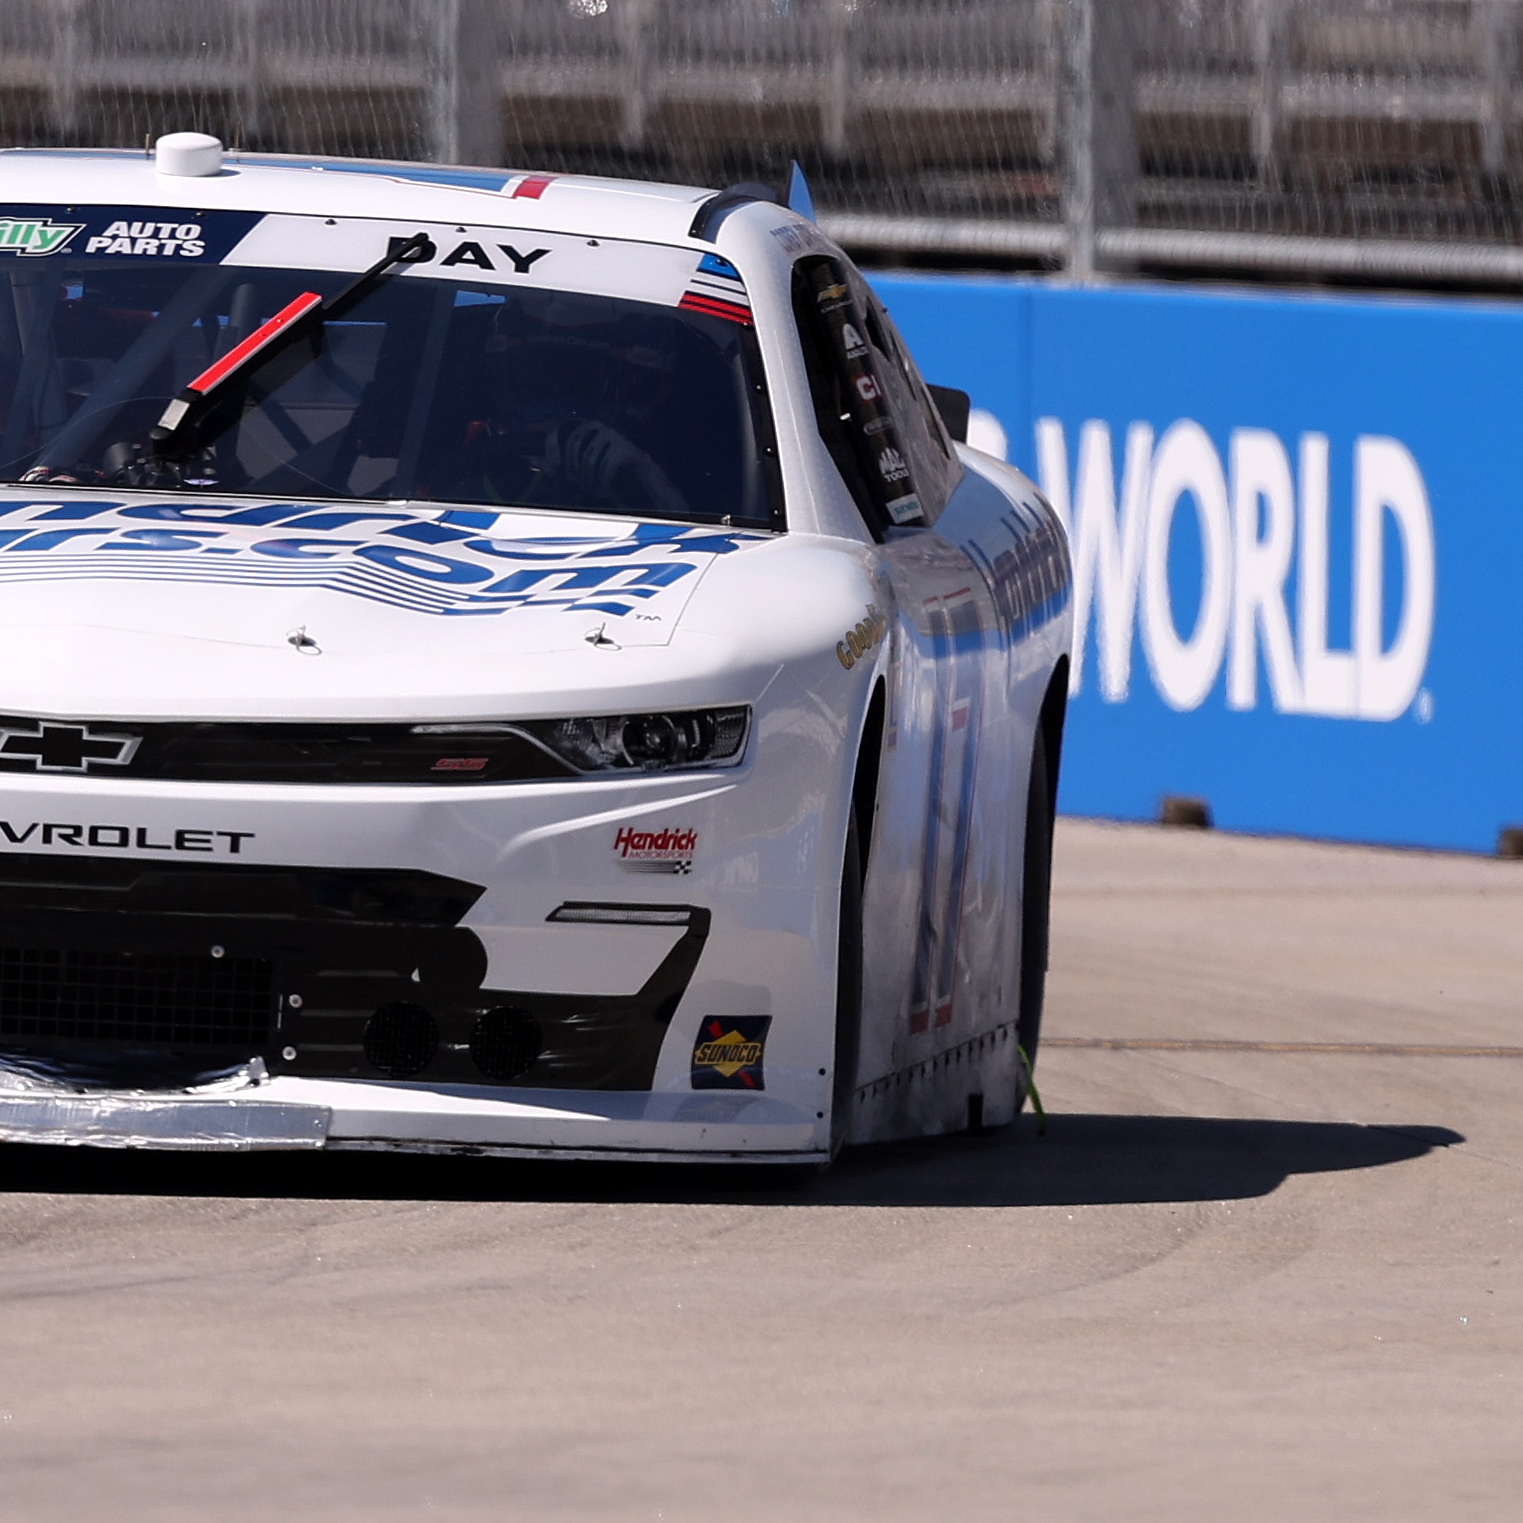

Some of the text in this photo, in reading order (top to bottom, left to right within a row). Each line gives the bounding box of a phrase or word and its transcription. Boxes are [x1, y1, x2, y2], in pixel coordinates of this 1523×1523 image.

[101, 220, 202, 238] AUTO
[85, 236, 206, 256] PARTS
[387, 235, 553, 274] DAY
[1034, 415, 1436, 722] WORLD
[613, 827, 698, 858] Hendrick
[696, 1044, 760, 1063] SUNOCO
